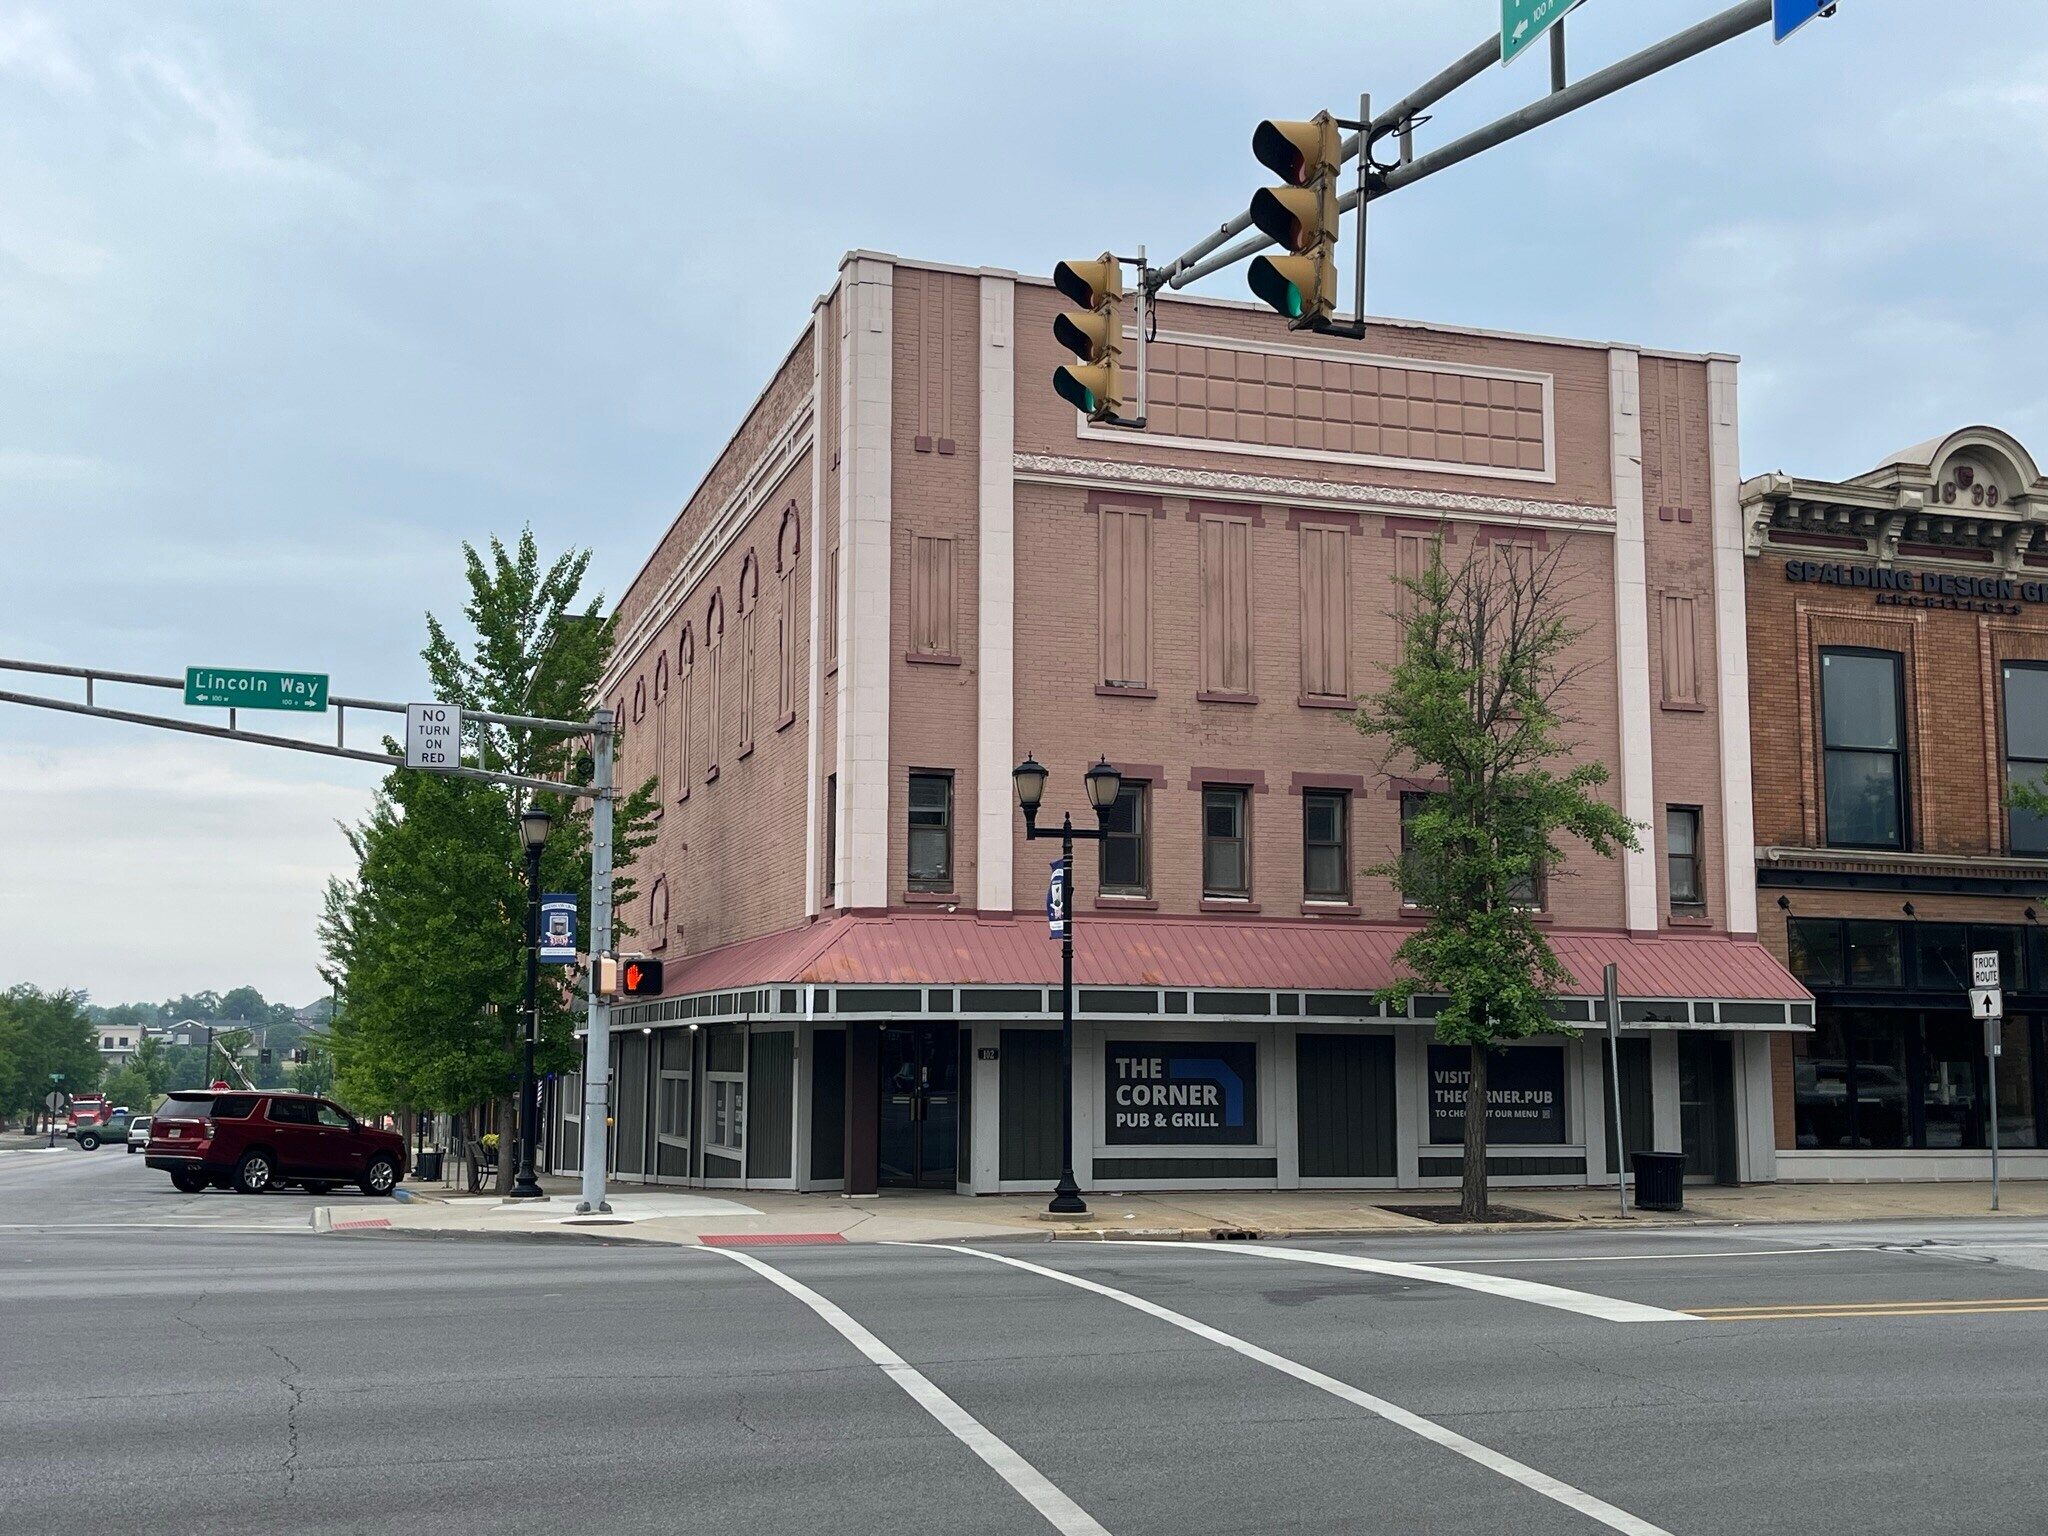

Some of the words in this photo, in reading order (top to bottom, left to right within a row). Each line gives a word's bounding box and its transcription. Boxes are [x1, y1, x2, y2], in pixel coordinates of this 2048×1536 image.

[1533, 2, 1547, 23] 100
[1786, 559, 1914, 591] SPALDING
[1922, 573, 2015, 600] DESIGN
[195, 673, 268, 692] Lincoln
[280, 678, 319, 697] Way
[423, 709, 446, 722] NO
[419, 725, 450, 735] TURN
[425, 738, 442, 749] ON
[421, 752, 445, 763] RED
[1974, 957, 1997, 968] TRUCK
[1975, 970, 1998, 982] ROUTE
[1115, 1058, 1162, 1079] THE
[1434, 1070, 1471, 1084] VISIT
[1116, 1084, 1219, 1106] CORNER
[1435, 1090, 1553, 1104] THECRNER.PUB
[1116, 1113, 1150, 1128] PUB
[1154, 1113, 1168, 1127] &
[1171, 1113, 1219, 1127] GRILL
[1435, 1109, 1447, 1118] TO
[1495, 1110, 1513, 1118] OUR
[1514, 1110, 1539, 1118] MENU
